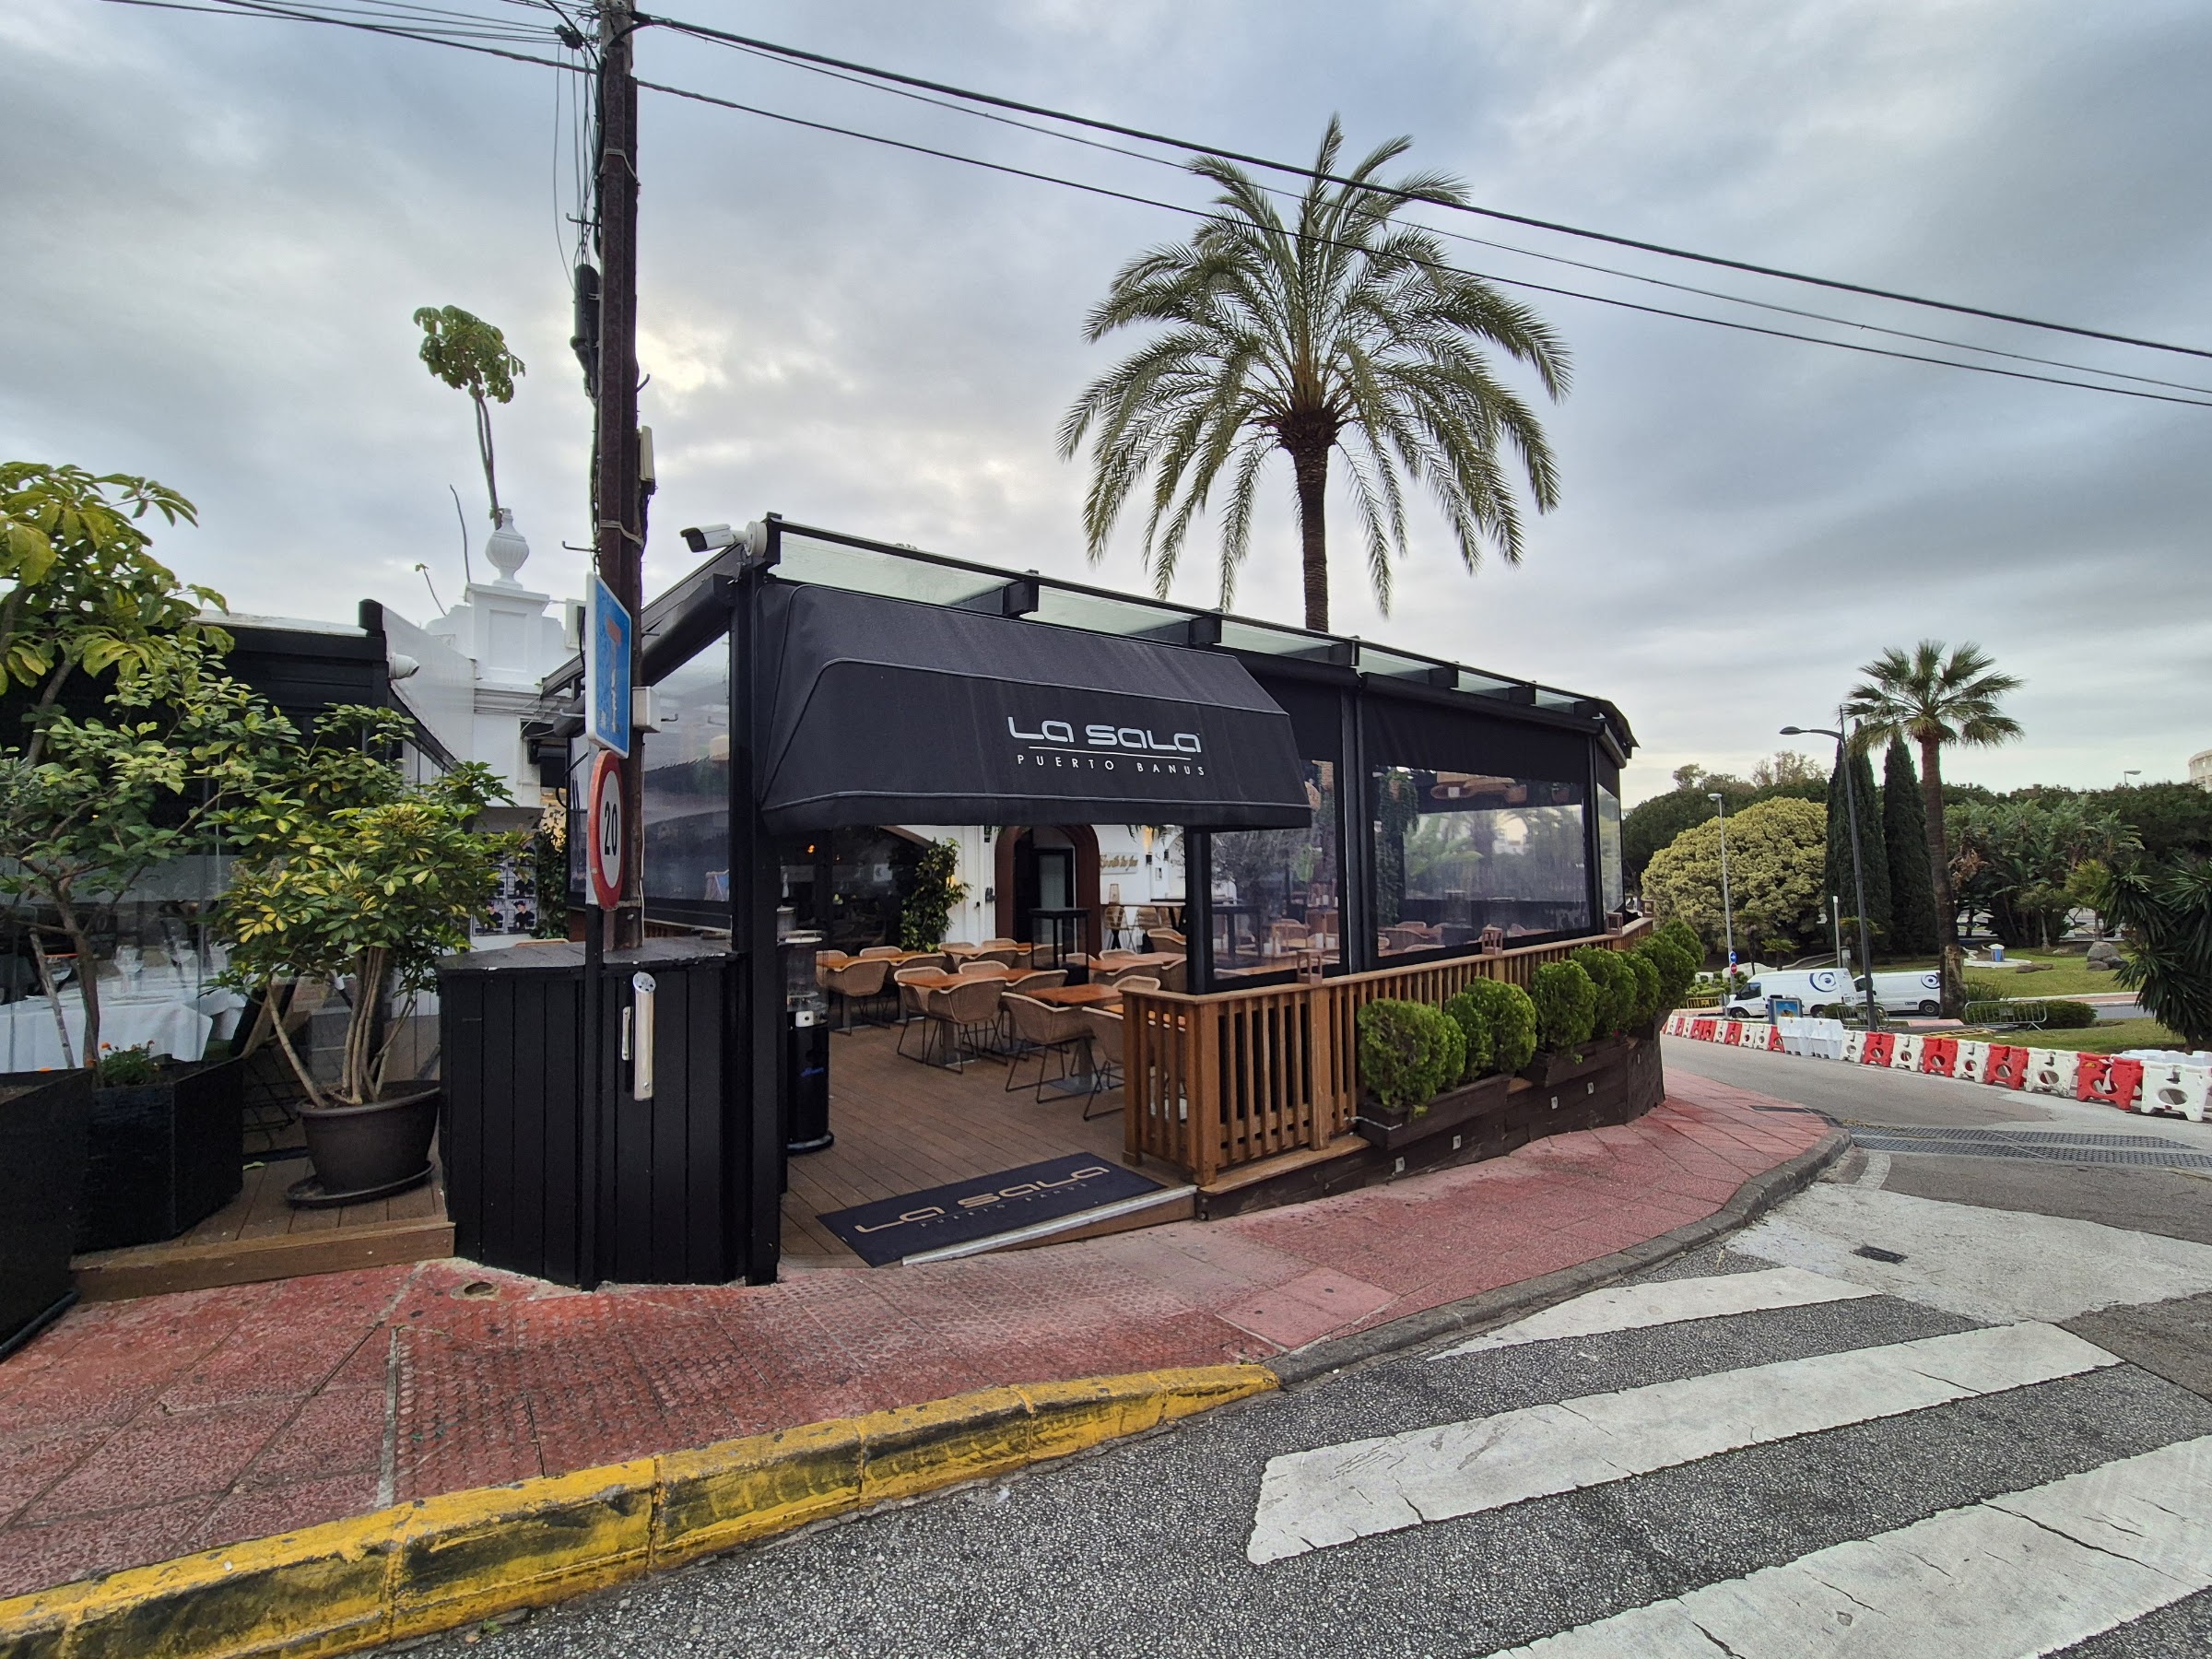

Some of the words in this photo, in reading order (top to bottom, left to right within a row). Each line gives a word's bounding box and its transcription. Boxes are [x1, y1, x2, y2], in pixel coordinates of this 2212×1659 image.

[1017, 754, 1114, 771] PUERTO
[1136, 762, 1205, 776] BANUS
[604, 800, 618, 856] 20
